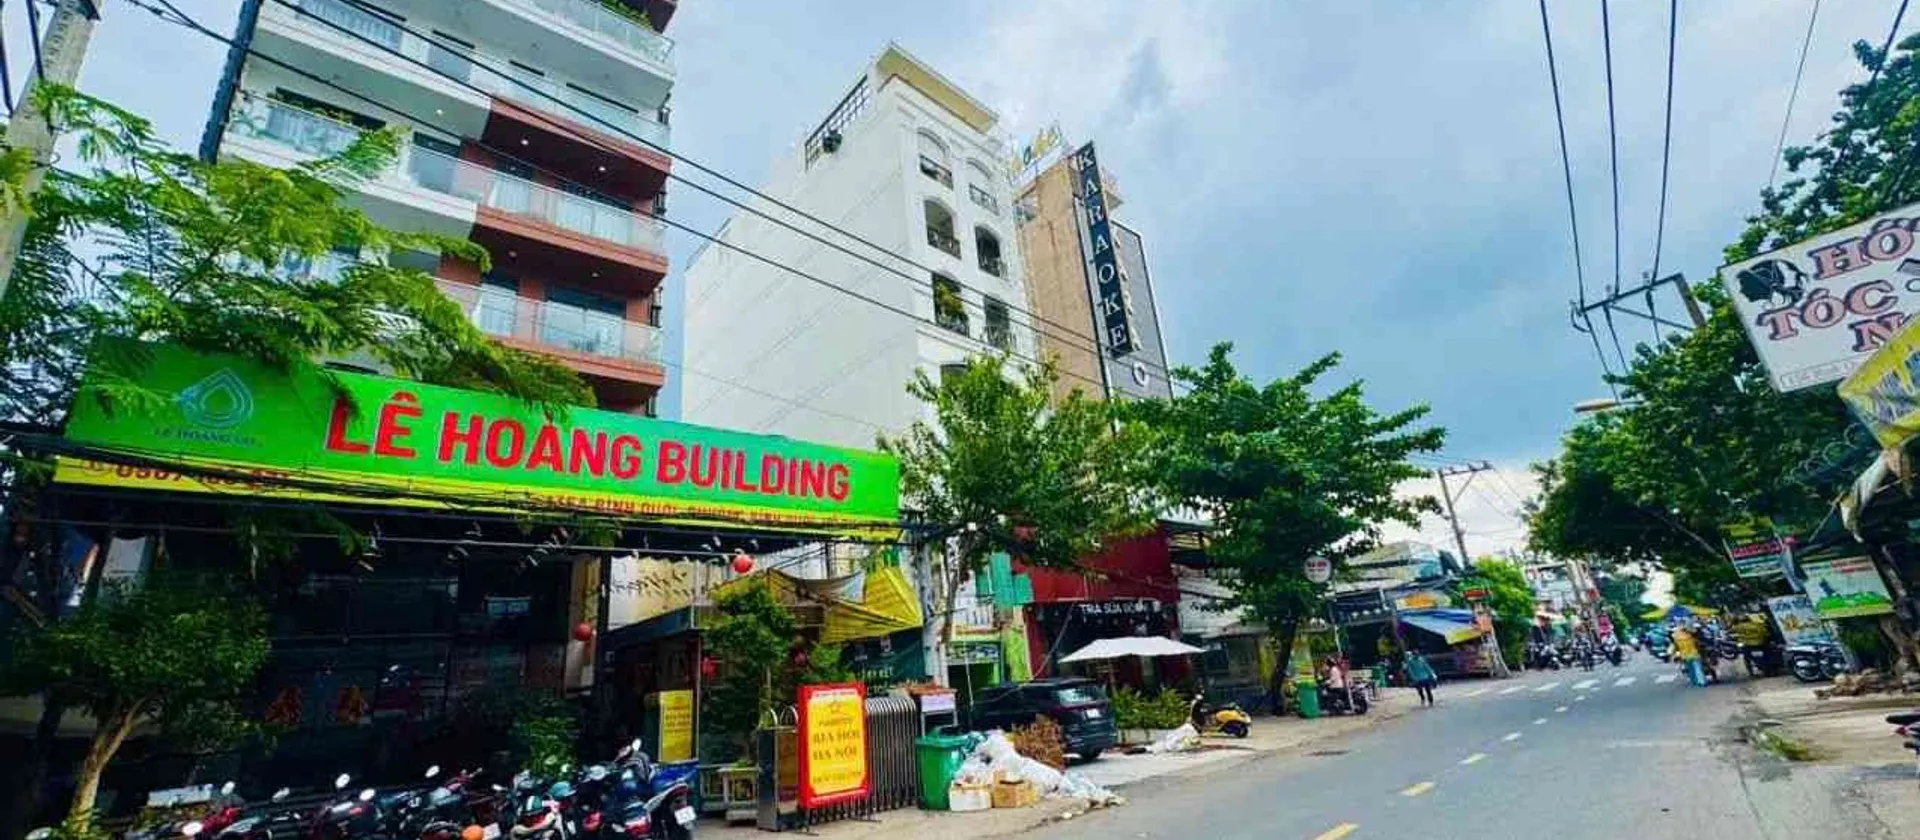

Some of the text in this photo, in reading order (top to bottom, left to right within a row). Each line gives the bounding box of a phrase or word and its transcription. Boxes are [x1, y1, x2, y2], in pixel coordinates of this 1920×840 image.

[1076, 150, 1127, 348] KARAOKE
[1755, 279, 1898, 341] TÓC
[325, 391, 422, 459] LÊ
[655, 439, 850, 502] BUILDING
